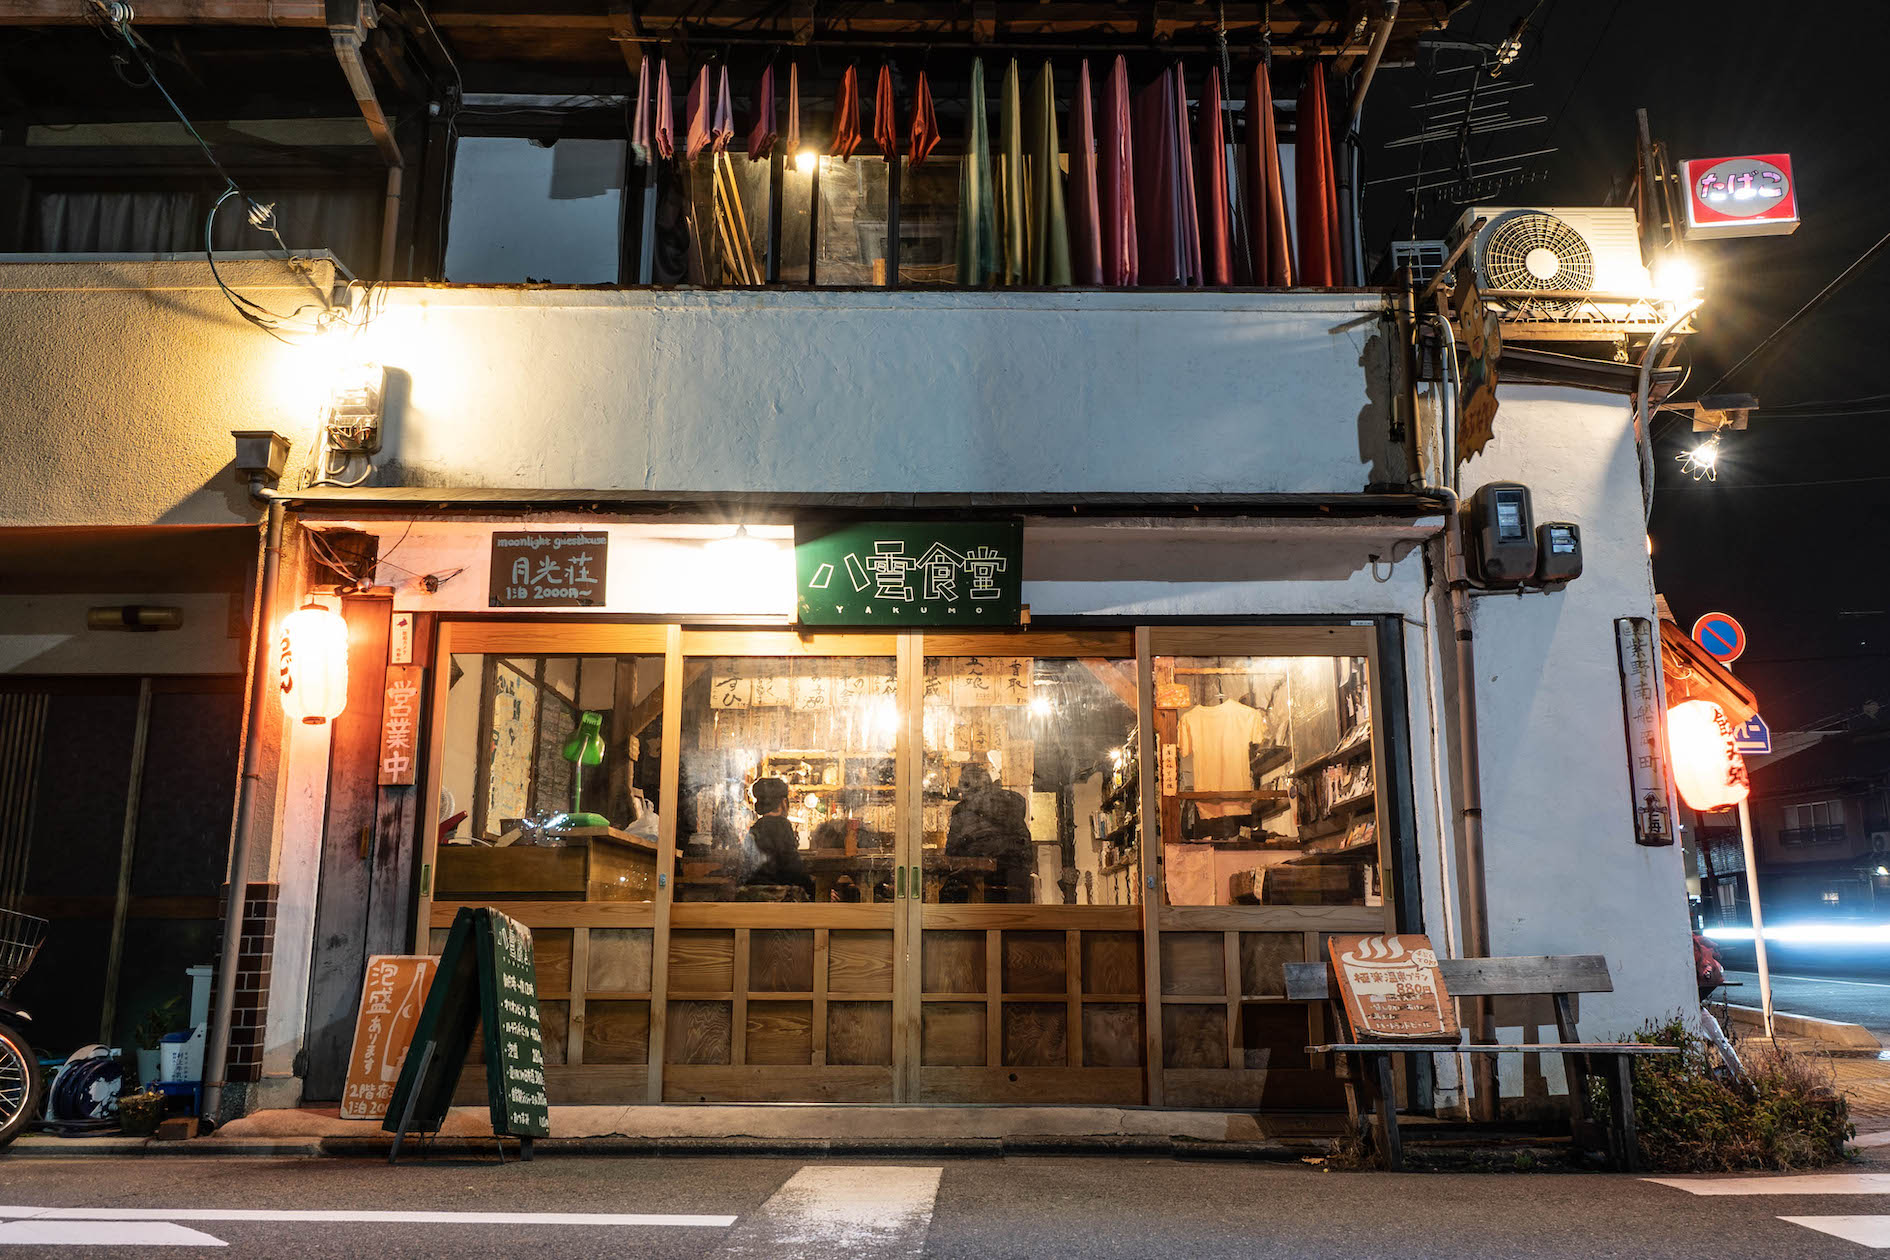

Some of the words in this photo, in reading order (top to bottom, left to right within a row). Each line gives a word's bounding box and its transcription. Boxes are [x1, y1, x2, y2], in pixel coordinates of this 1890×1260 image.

[1700, 170, 1782, 200] たばこ
[497, 535, 552, 549] moonlight
[553, 534, 607, 549] guesthouse
[512, 552, 598, 585] 月光荘
[808, 541, 1007, 602] 八雲食堂
[506, 586, 528, 600] 1泊
[836, 605, 983, 614] YAKUMO
[383, 680, 417, 783] 営業中
[1353, 971, 1428, 983] 極楽温泉プラン
[1396, 983, 1432, 995] 880円
[364, 962, 399, 1075] 泡盛あります
[349, 1083, 394, 1100] 2階宿
[348, 1102, 367, 1115] 1泊
